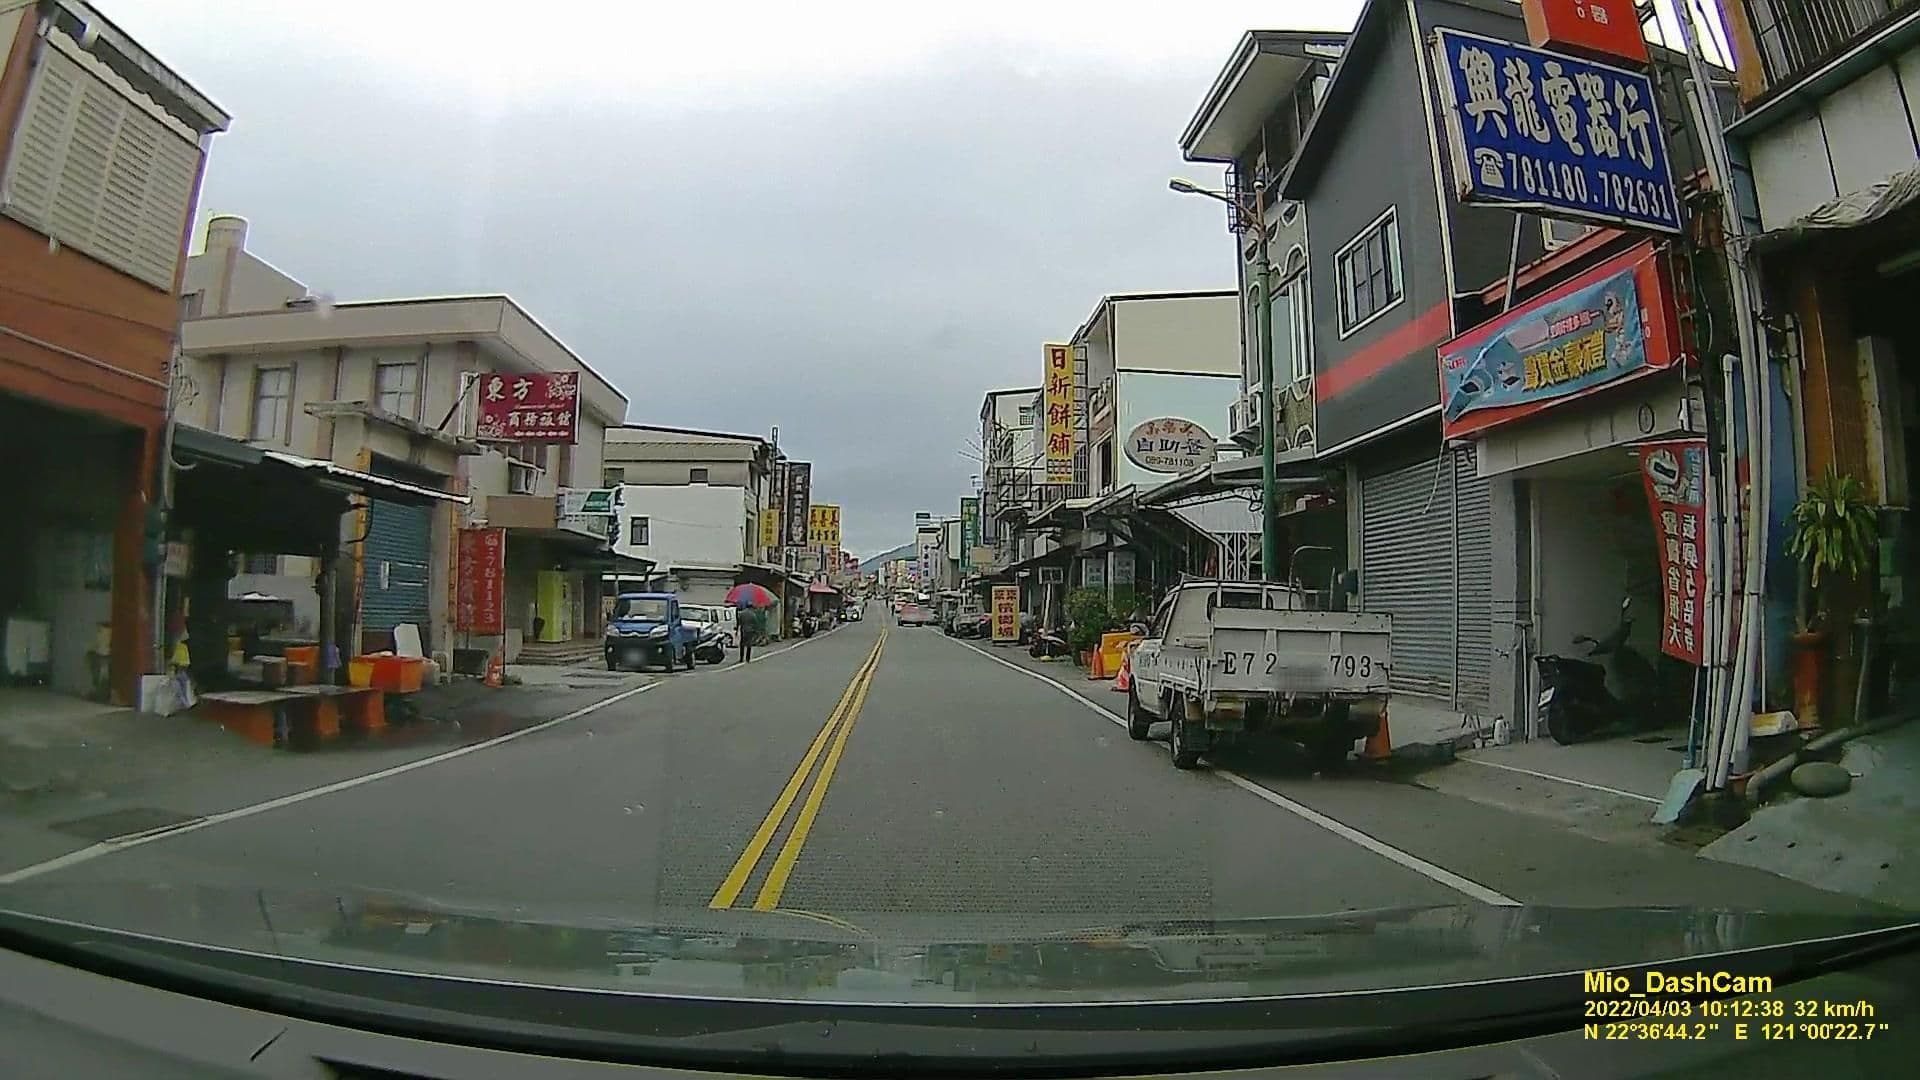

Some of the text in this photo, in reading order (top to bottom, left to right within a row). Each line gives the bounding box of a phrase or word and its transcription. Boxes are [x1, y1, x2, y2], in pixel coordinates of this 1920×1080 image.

[1458, 45, 1655, 170] 興龍電器行
[486, 376, 534, 402] 東方
[508, 410, 572, 428] 商務旅館
